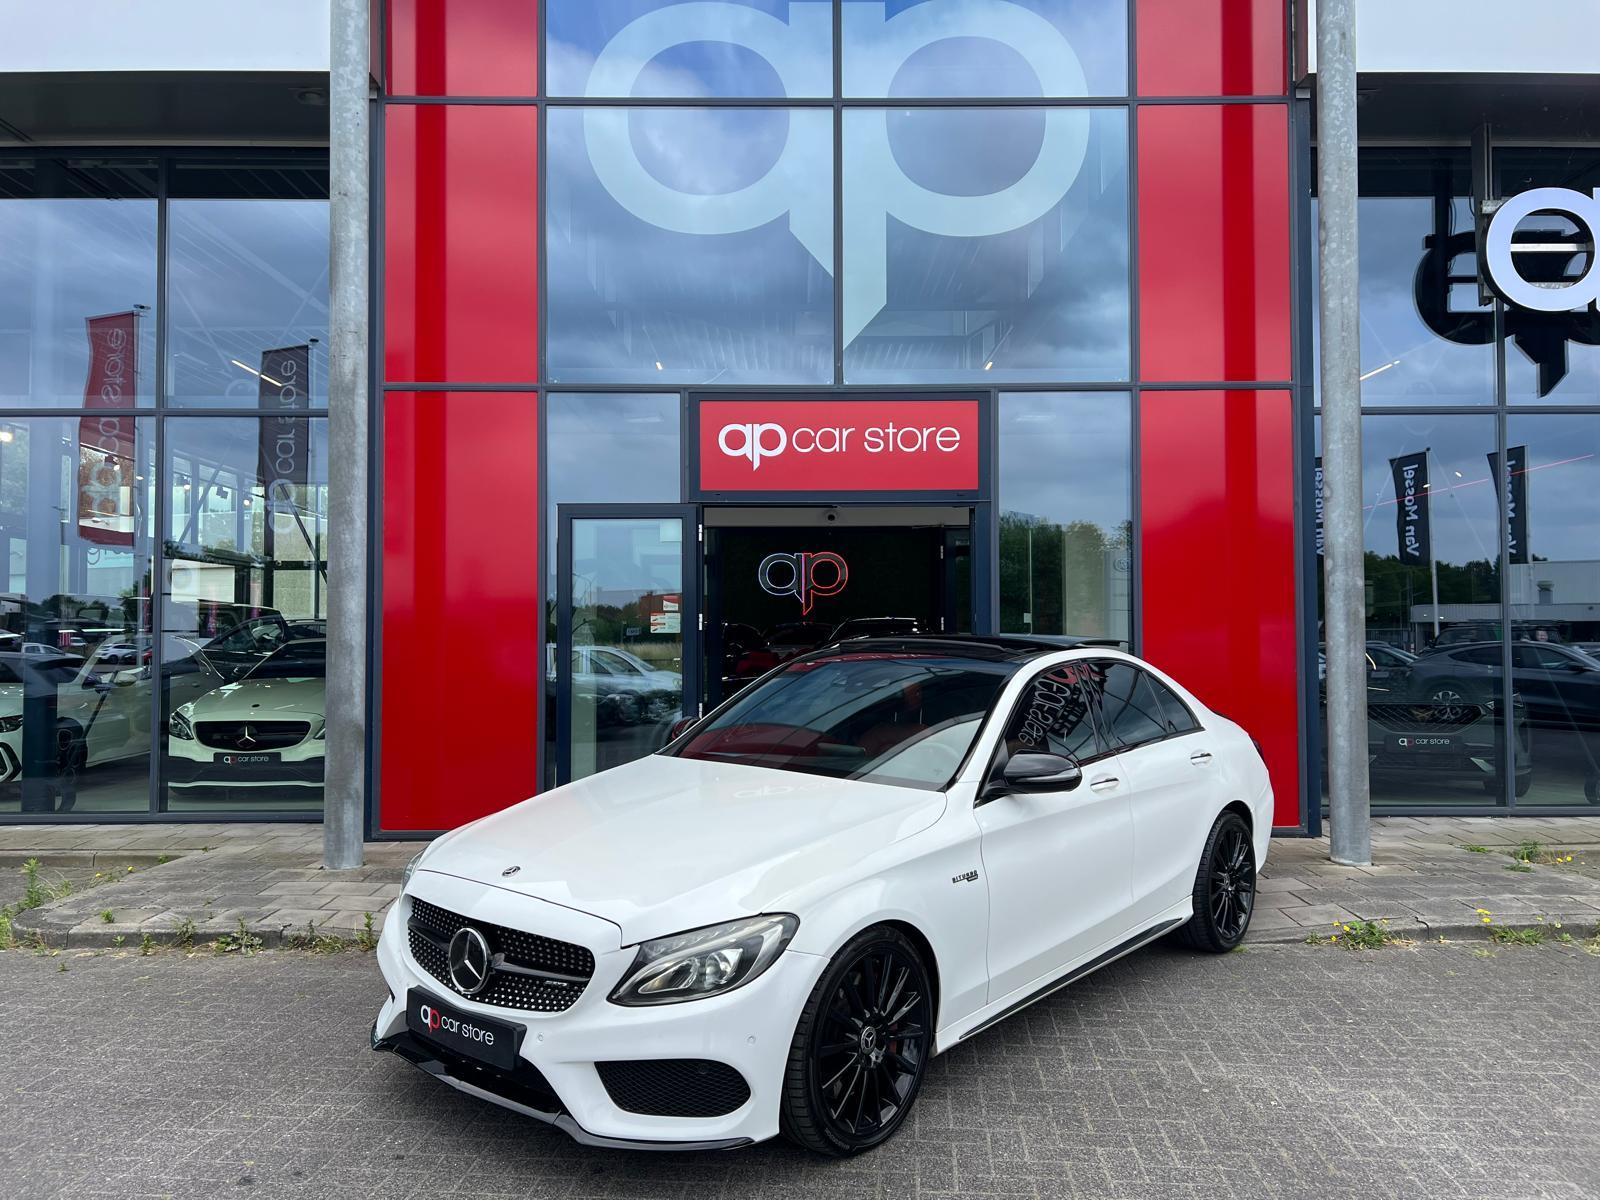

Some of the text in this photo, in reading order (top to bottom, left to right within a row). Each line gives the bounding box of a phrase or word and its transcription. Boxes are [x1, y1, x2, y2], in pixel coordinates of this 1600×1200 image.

[792, 427, 855, 453] car
[864, 421, 961, 453] store
[441, 1016, 460, 1034] car
[461, 1023, 494, 1046] store
